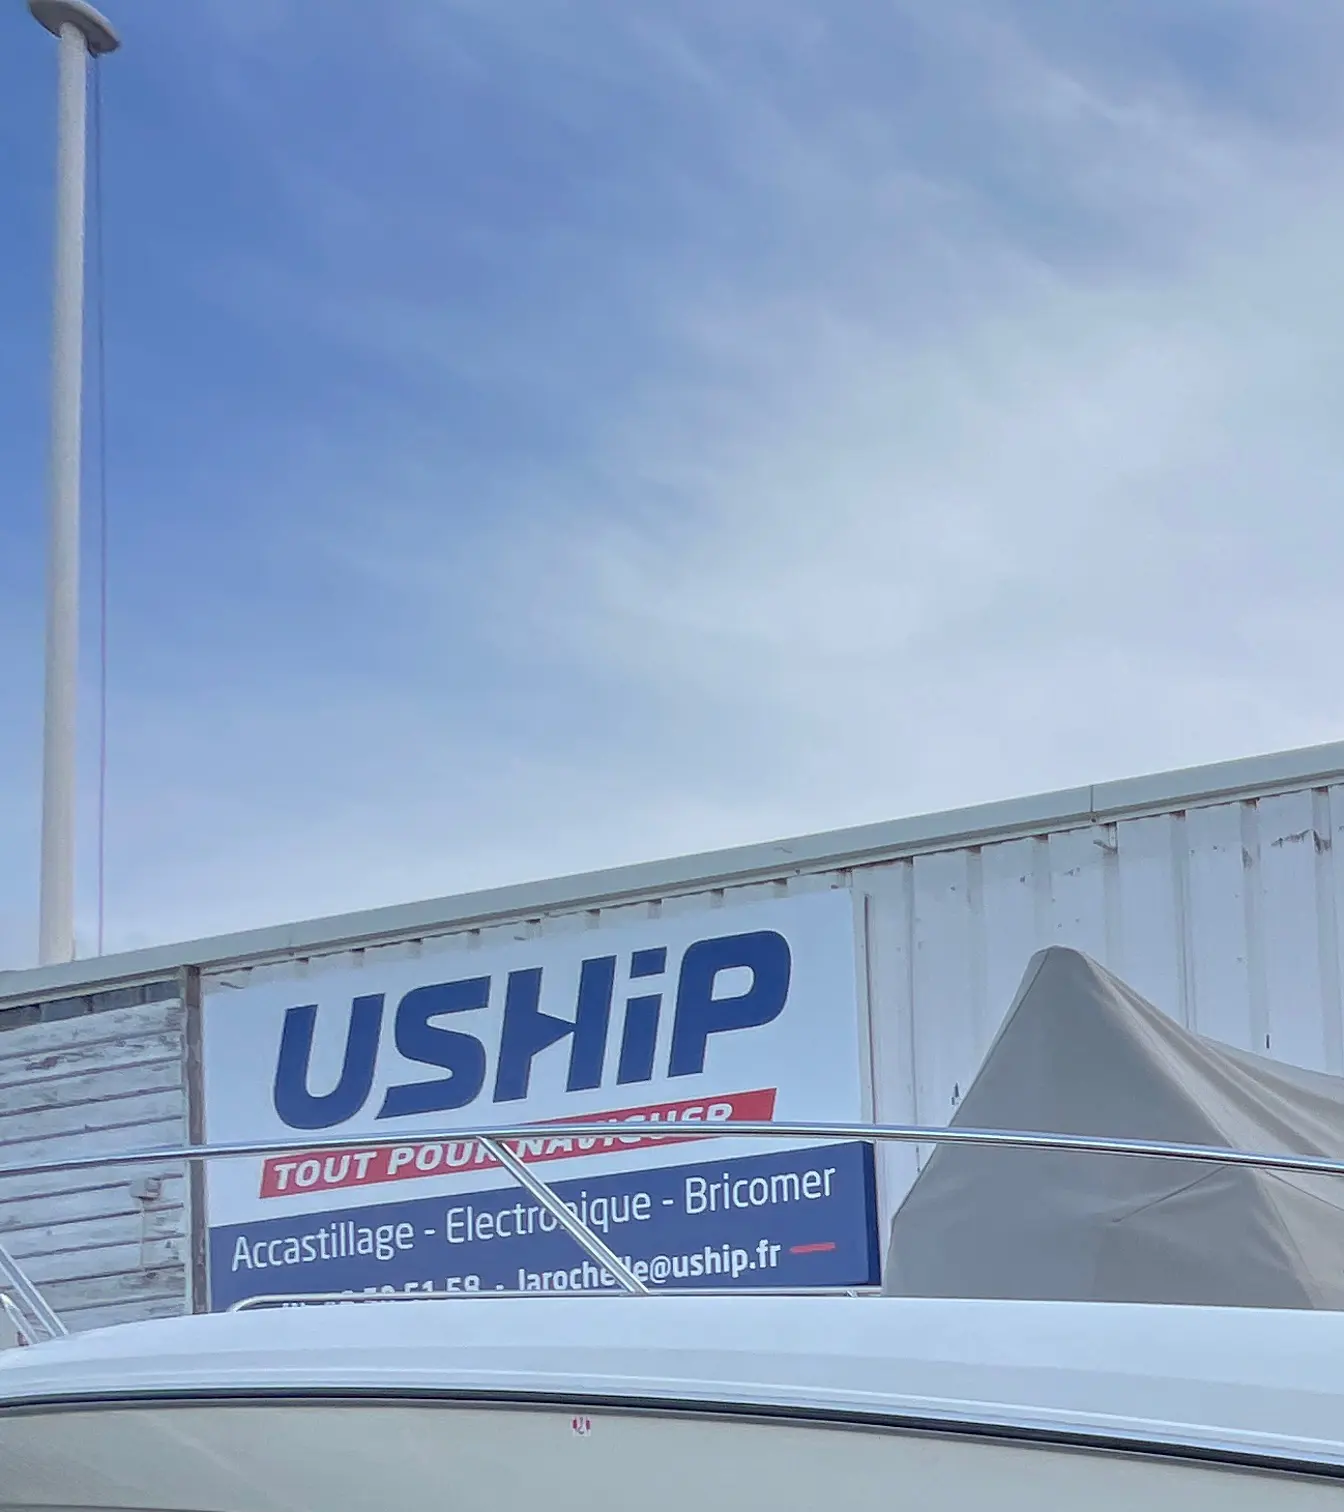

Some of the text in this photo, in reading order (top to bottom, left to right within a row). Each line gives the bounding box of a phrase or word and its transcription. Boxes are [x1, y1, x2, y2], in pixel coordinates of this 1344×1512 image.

[273, 1151, 378, 1191] TOUT
[231, 1220, 415, 1272] Accastillage
[685, 1167, 836, 1215] Bricomer
[518, 1239, 781, 1291] larochele@uship.fr
